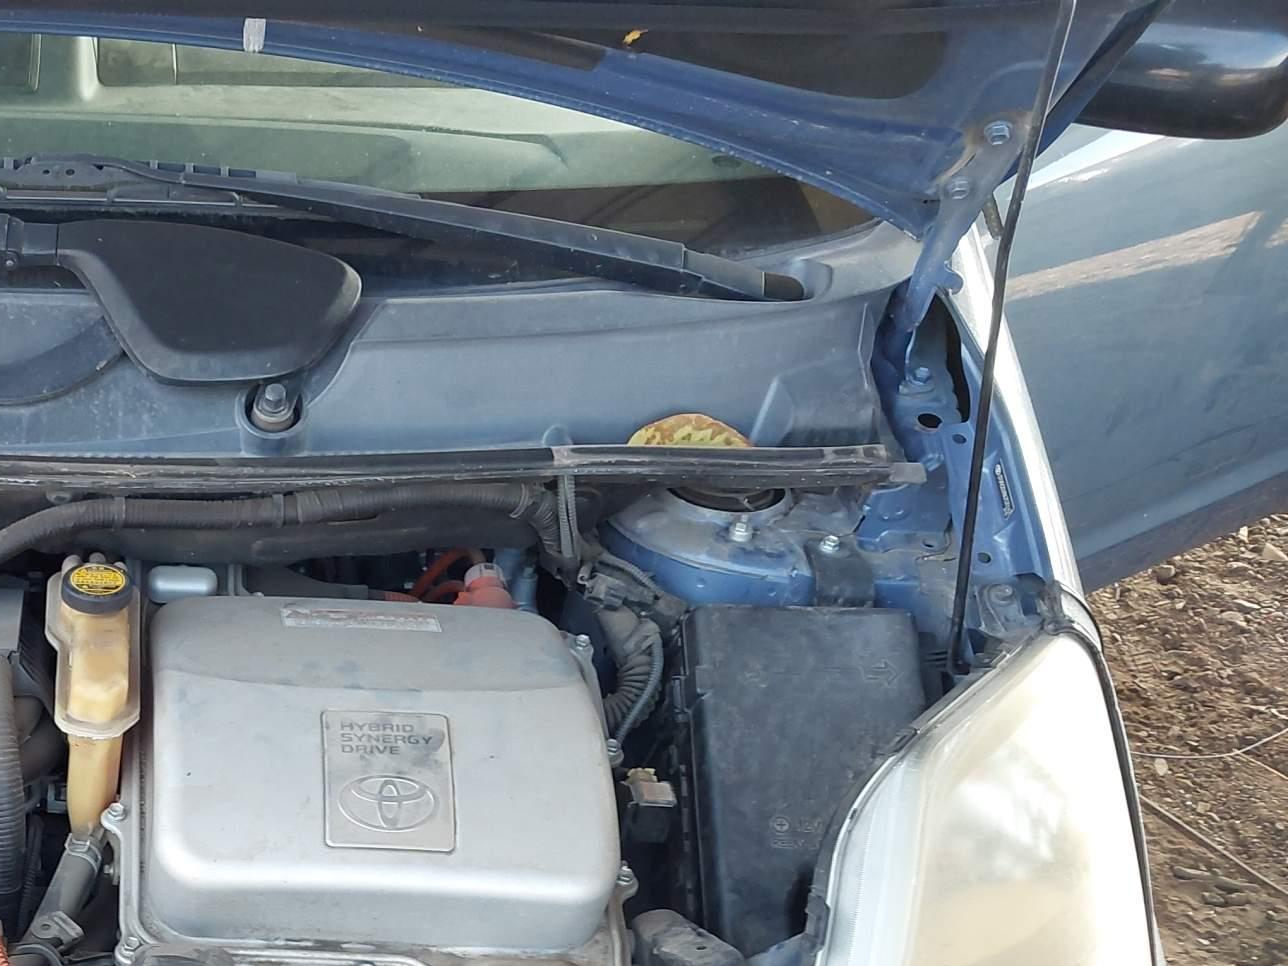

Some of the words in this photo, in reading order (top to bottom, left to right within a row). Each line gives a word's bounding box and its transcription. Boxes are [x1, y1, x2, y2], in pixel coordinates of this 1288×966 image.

[340, 721, 414, 733] HYBRID
[340, 733, 433, 745] SYNERGY
[341, 744, 401, 755] DRIVE
